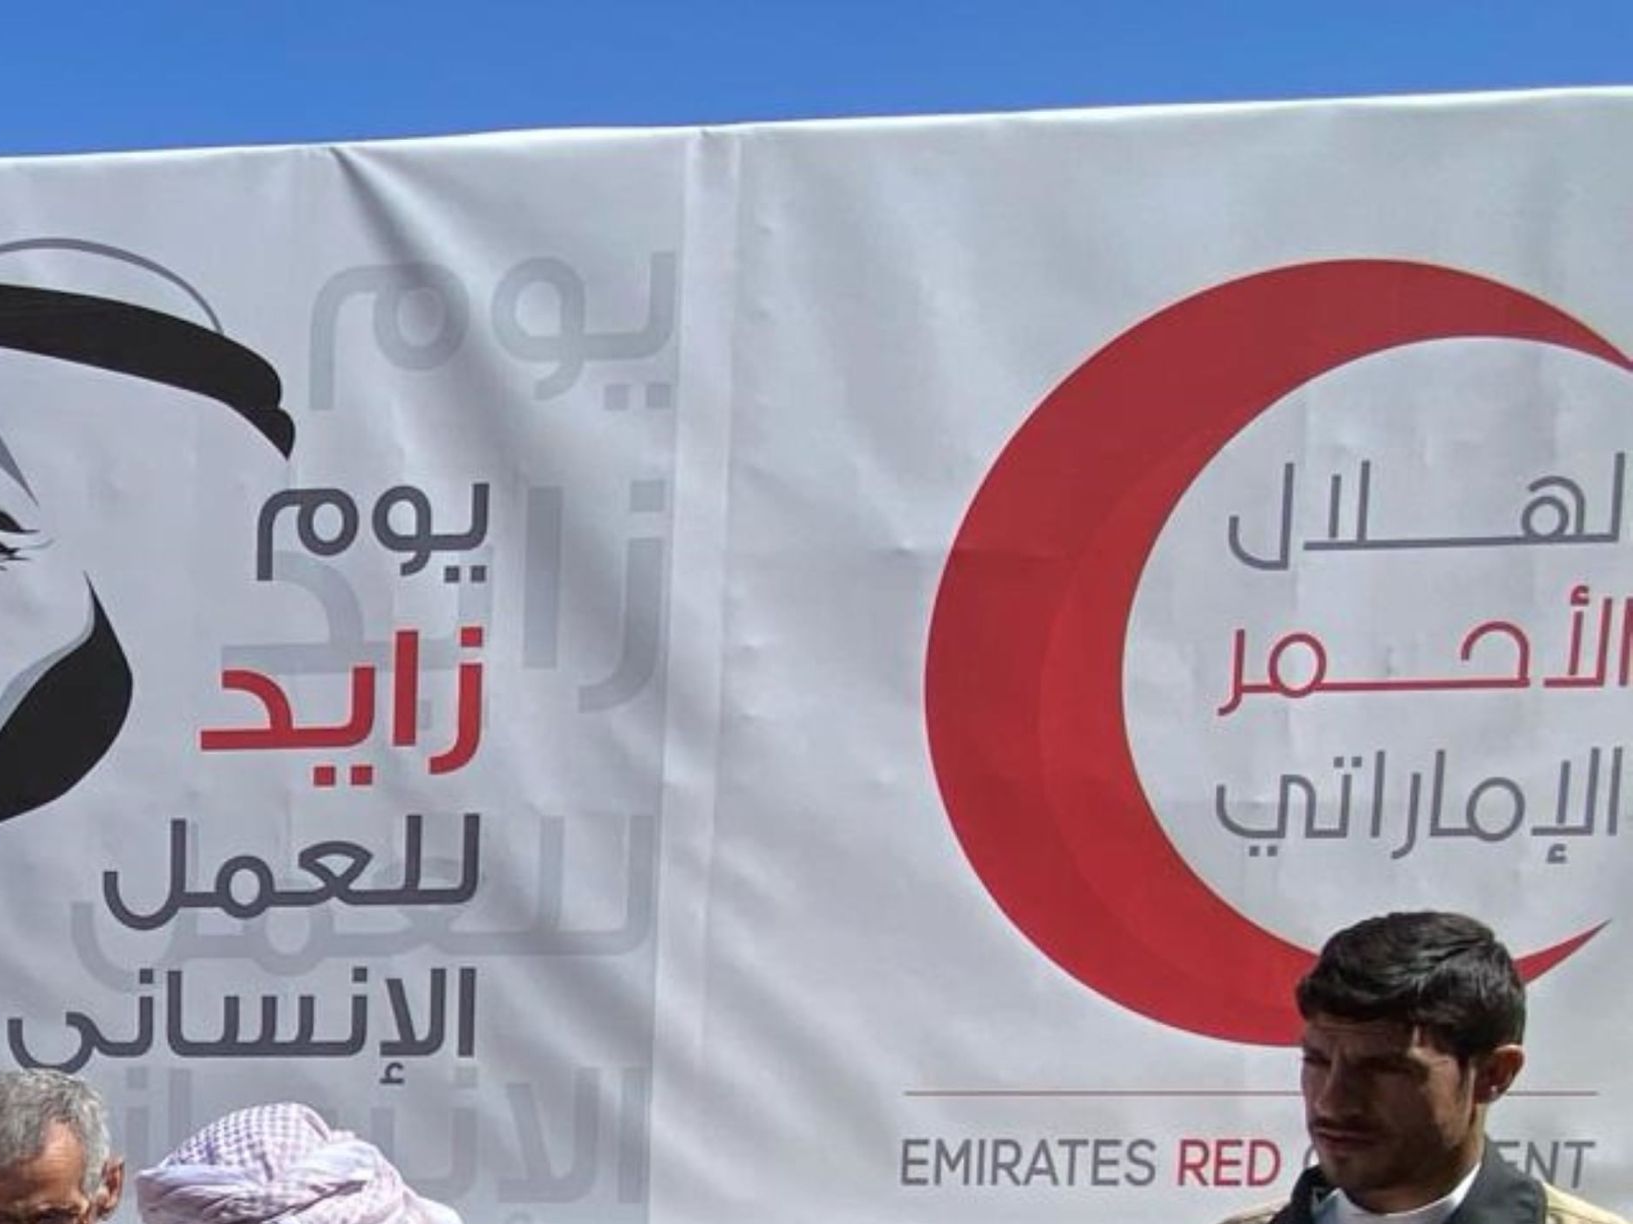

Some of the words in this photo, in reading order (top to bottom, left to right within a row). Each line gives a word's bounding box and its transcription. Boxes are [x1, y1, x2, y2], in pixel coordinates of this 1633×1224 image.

[257, 483, 489, 583] يوم
[1229, 452, 1625, 571] لهلال
[201, 627, 483, 786] زايد
[1217, 585, 1633, 716] الأحمر
[1216, 745, 1623, 864] الإماراتي
[103, 813, 480, 931] للعمل
[900, 1138, 1156, 1187] EMIRATES
[1177, 1138, 1282, 1187] RED
